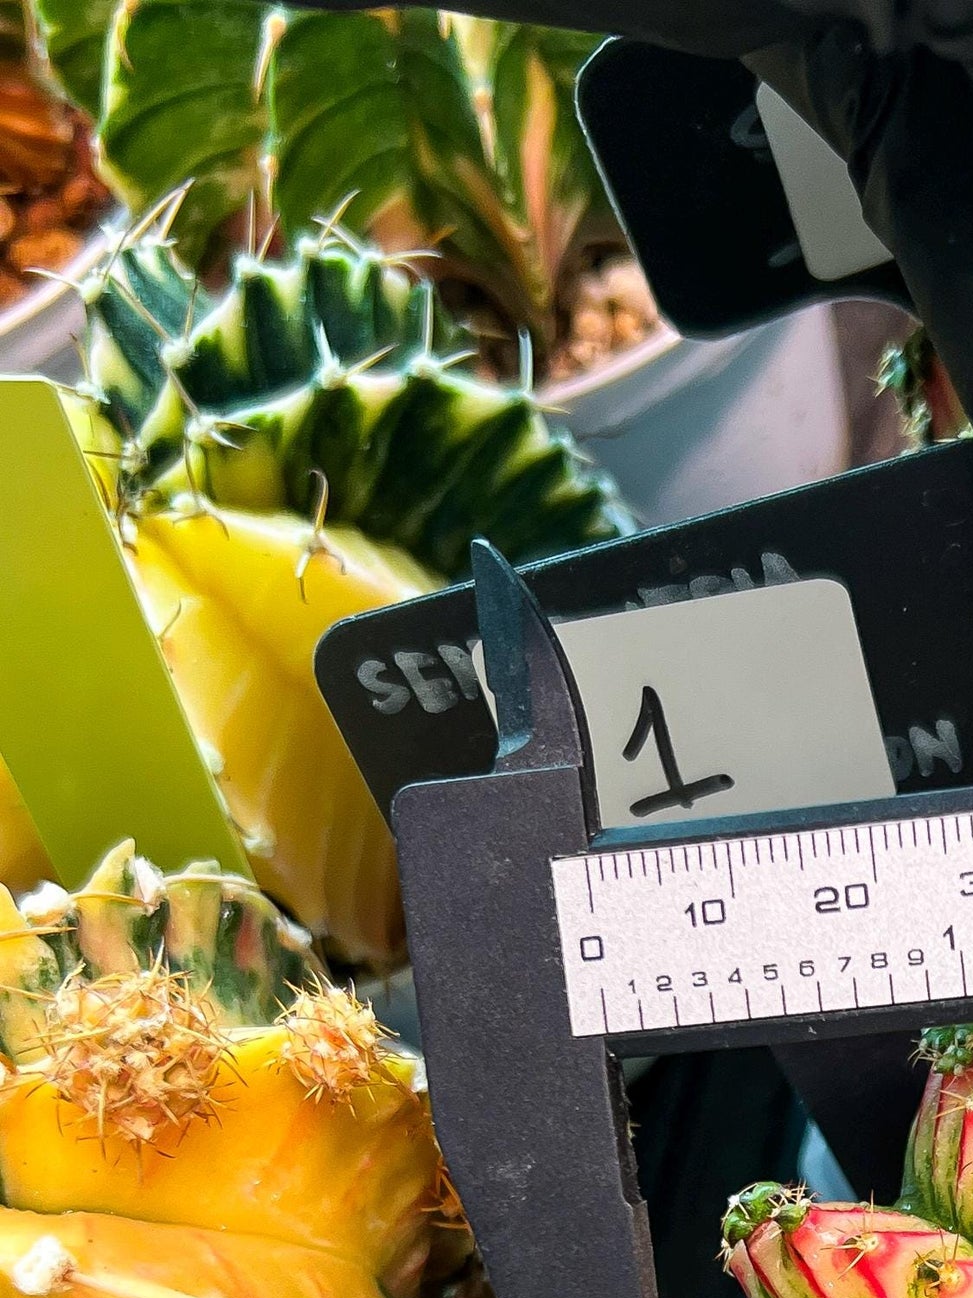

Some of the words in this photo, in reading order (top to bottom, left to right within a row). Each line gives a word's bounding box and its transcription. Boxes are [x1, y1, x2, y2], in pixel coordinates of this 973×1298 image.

[621, 686, 735, 818] 1
[580, 936, 604, 962] 0
[685, 899, 726, 927] 10
[814, 883, 869, 913] 20
[655, 974, 673, 992] 2
[691, 971, 709, 988] 3
[727, 967, 743, 984] 4
[762, 963, 779, 981] 5
[799, 959, 815, 978] 6
[837, 956, 852, 973] 7
[870, 952, 889, 970] 8
[907, 948, 925, 967] 9
[942, 924, 956, 951] 1
